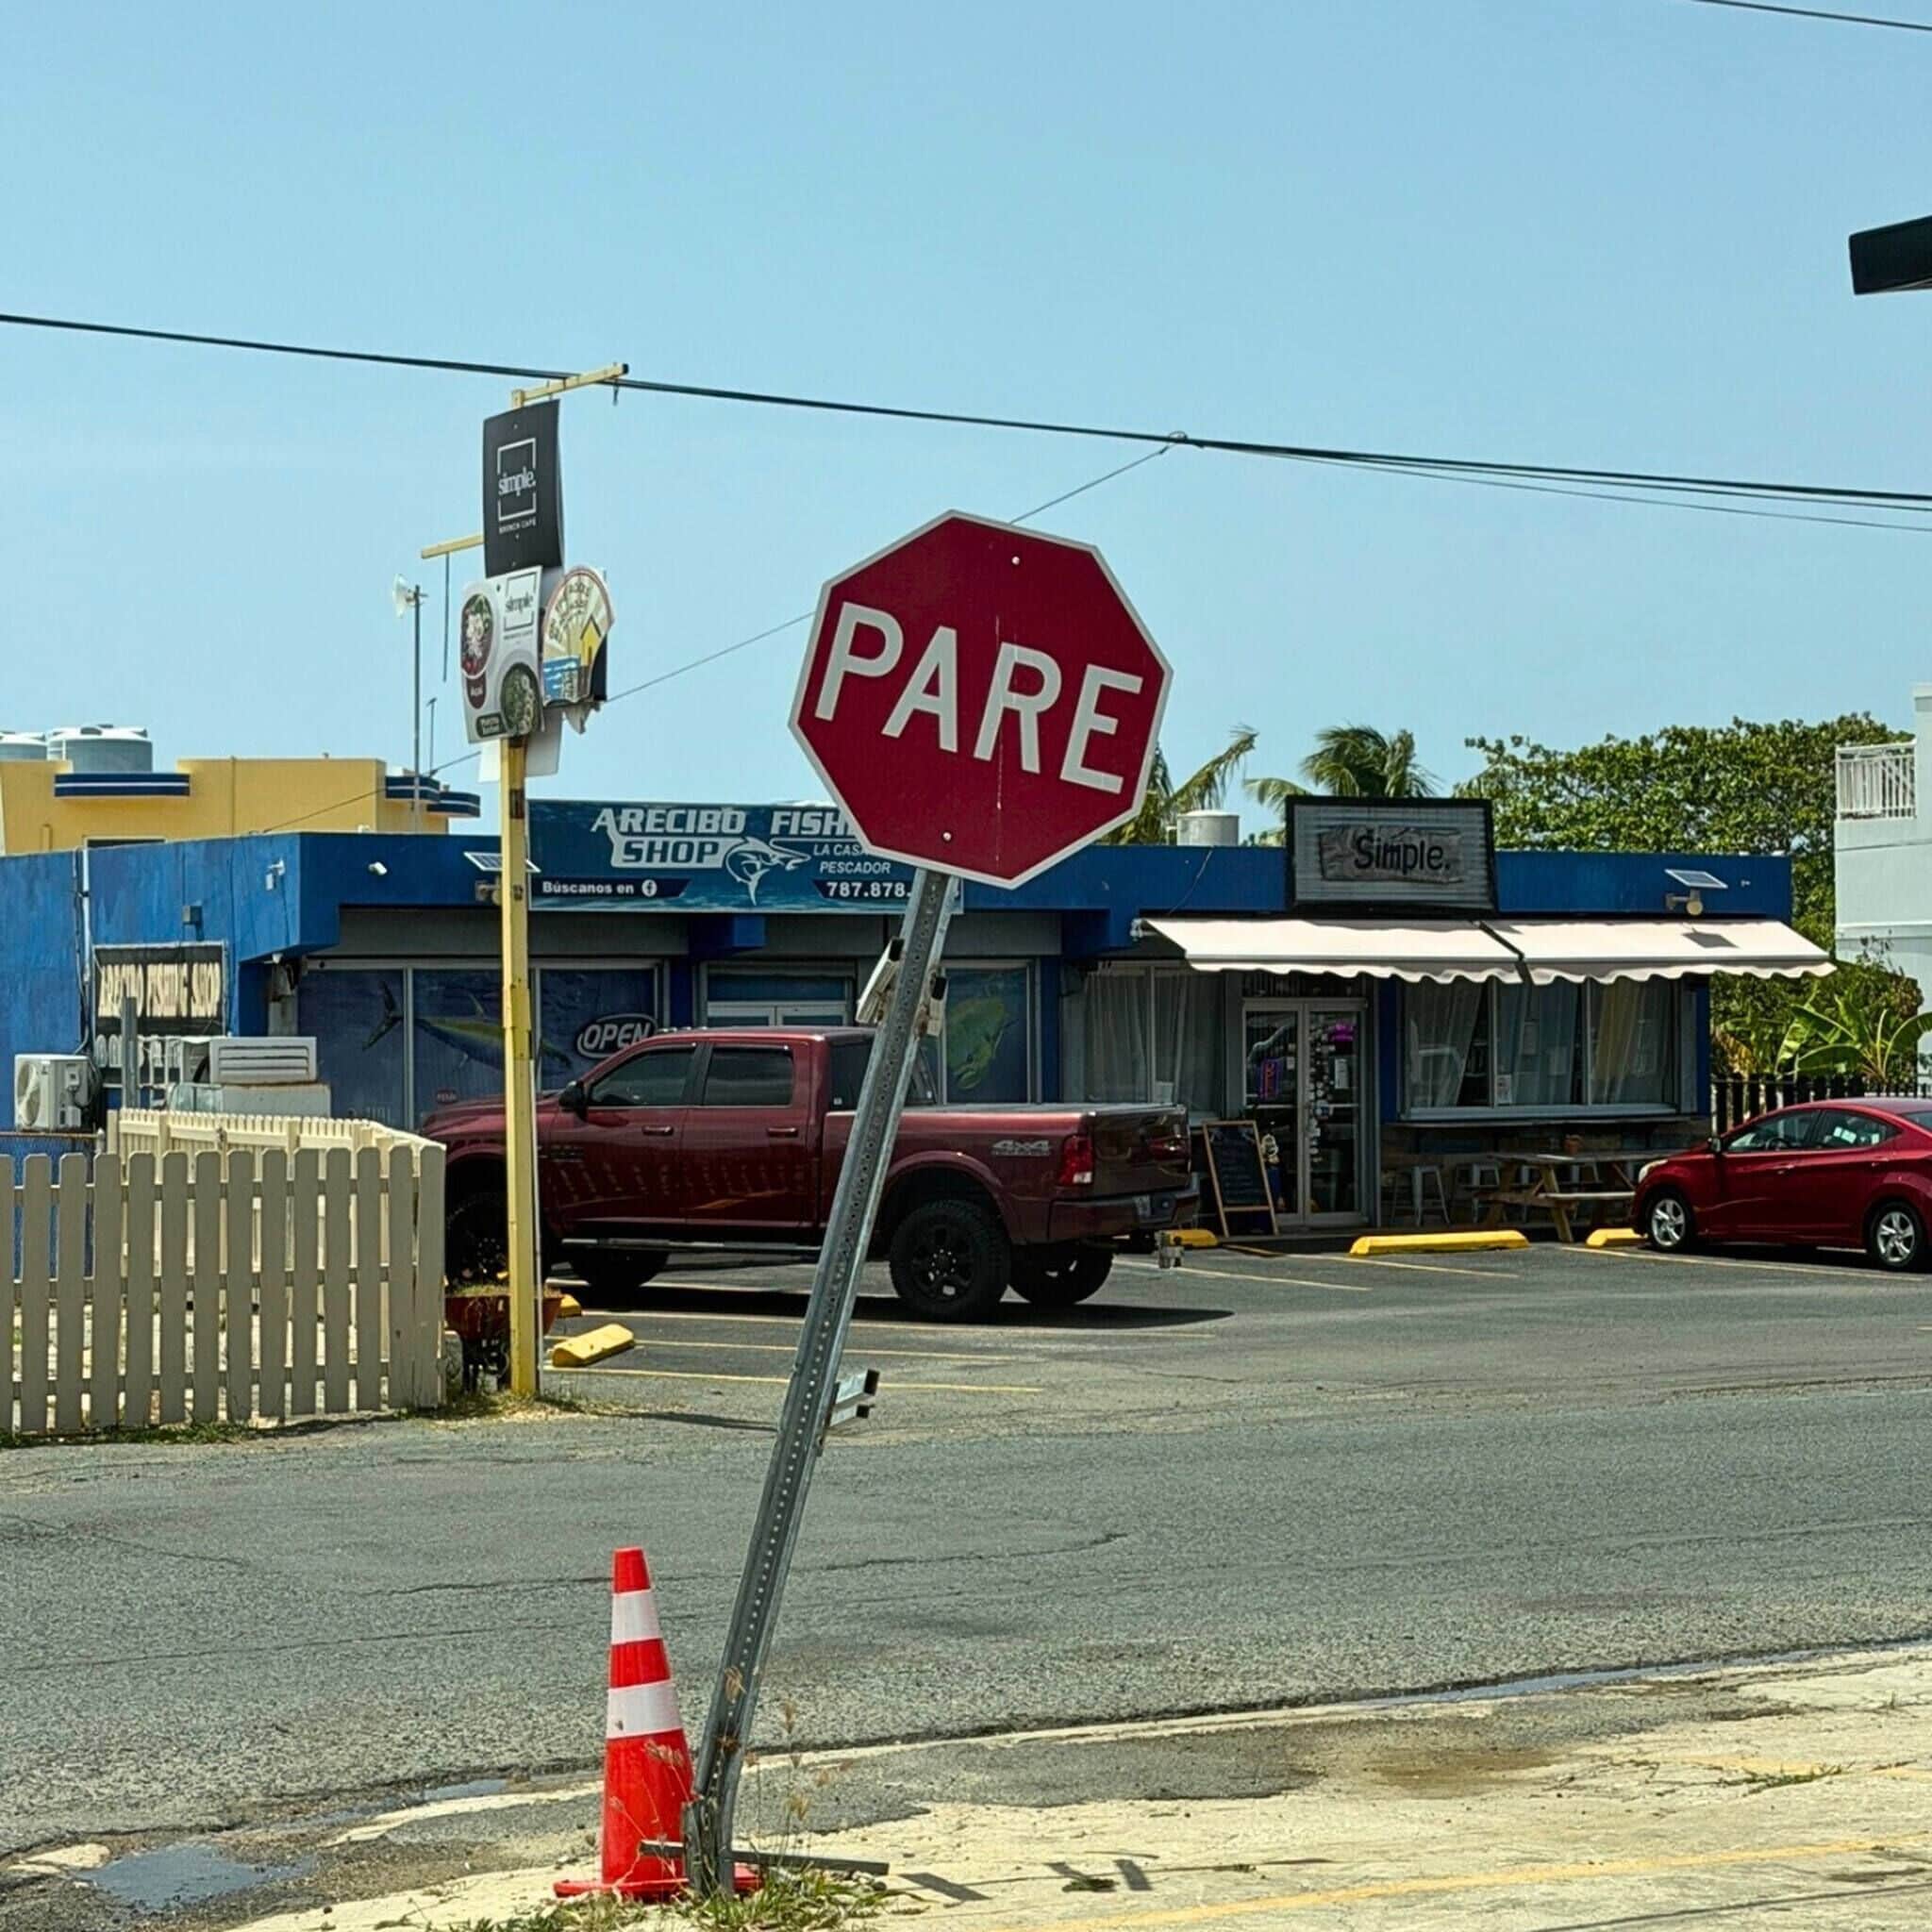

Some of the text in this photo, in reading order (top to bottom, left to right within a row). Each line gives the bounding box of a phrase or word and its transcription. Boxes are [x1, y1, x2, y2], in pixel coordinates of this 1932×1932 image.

[498, 466, 536, 496] simple.
[814, 600, 1143, 795] PARE
[591, 808, 746, 834] ARECIBO
[623, 840, 719, 863] SHOP
[813, 844, 831, 857] LA
[1354, 829, 1451, 874] Simple.
[819, 860, 891, 874] PESCADOR
[542, 880, 634, 893] Búscanos en
[583, 1022, 651, 1049] OPEN
